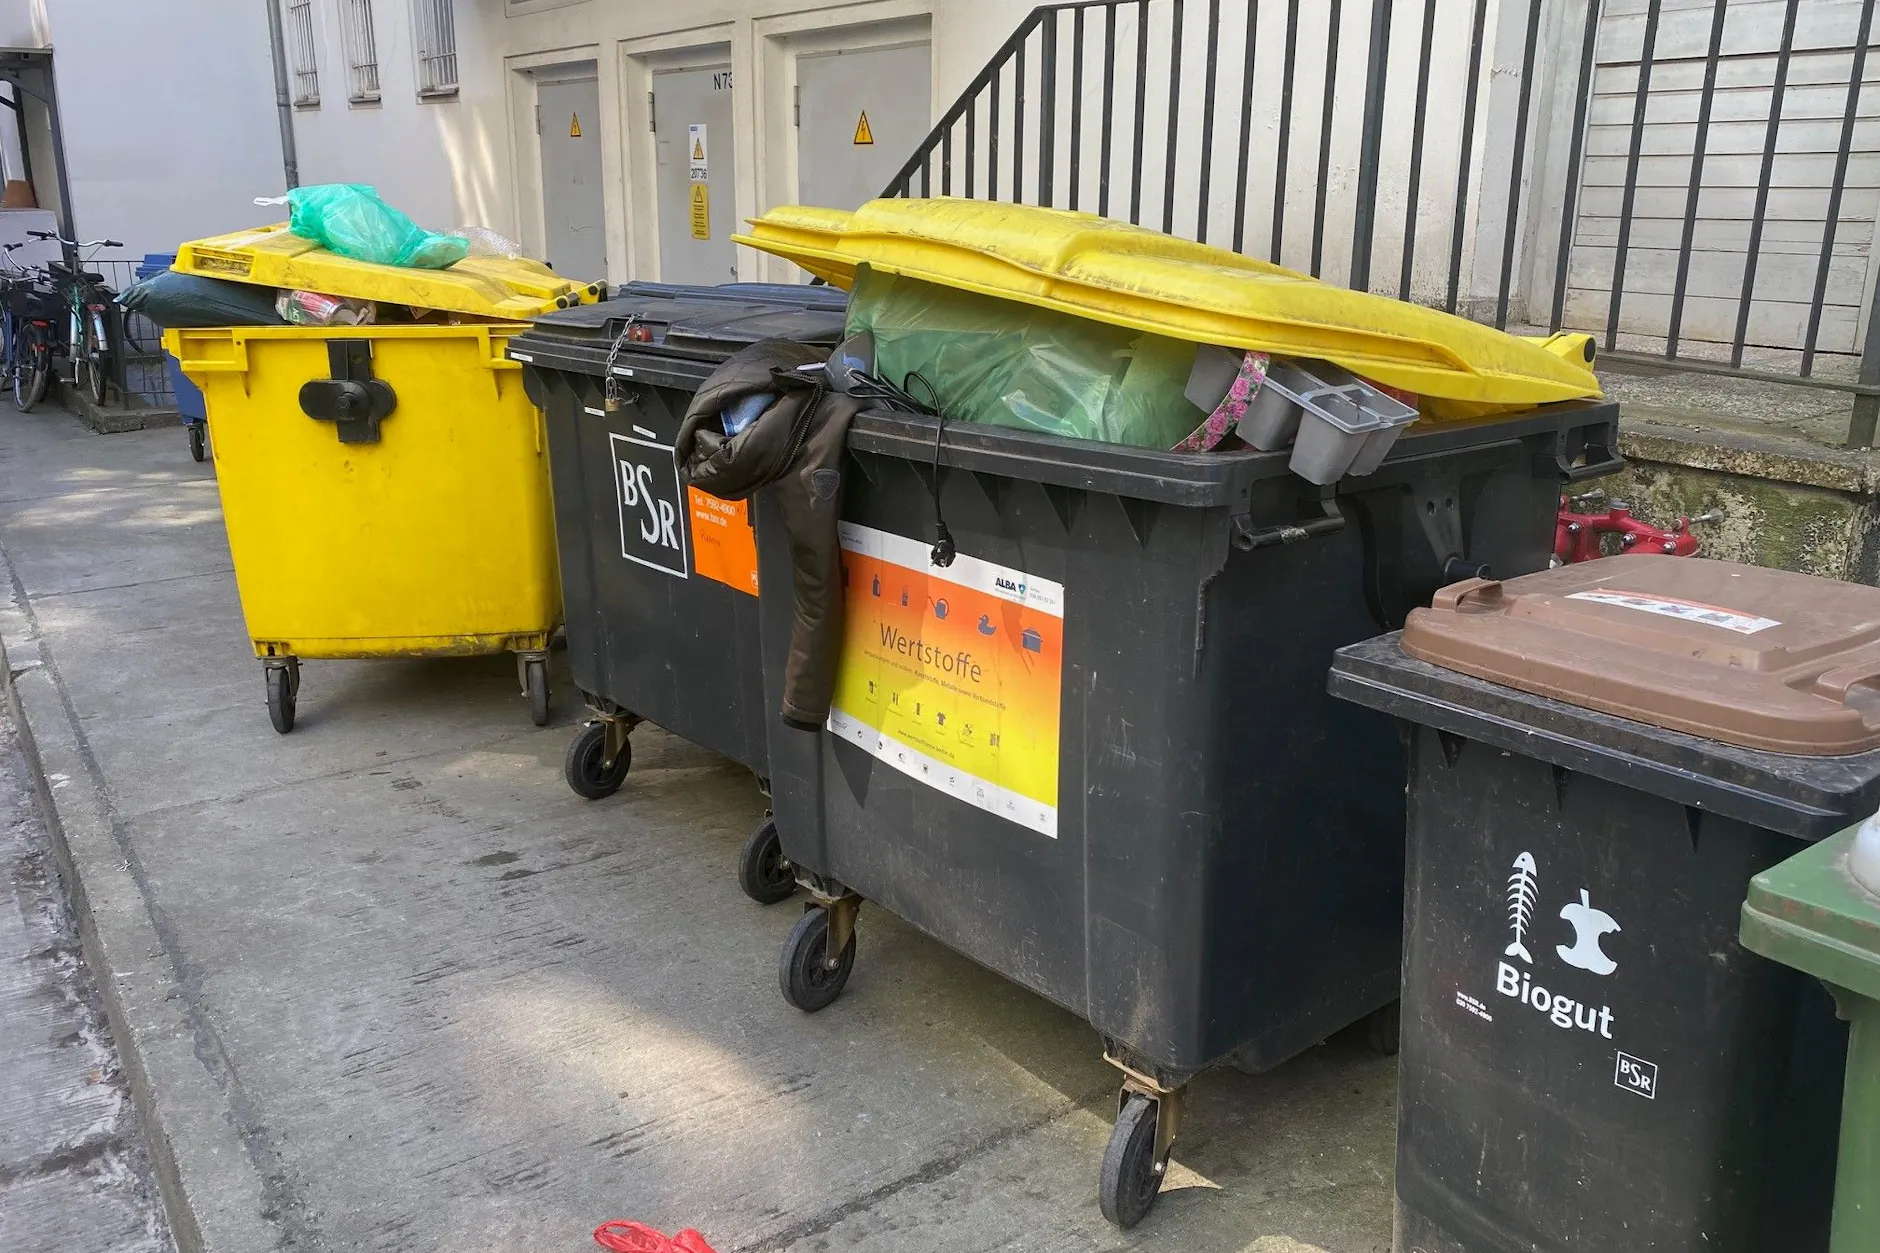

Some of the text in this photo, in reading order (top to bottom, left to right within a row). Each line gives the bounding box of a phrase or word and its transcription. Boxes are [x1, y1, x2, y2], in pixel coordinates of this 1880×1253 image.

[619, 459, 680, 551] BSR
[995, 577, 1017, 592] ALBA
[880, 622, 981, 683] Wertstoffe
[1496, 961, 1615, 1039] Biogut
[1620, 1059, 1652, 1091] BSR
